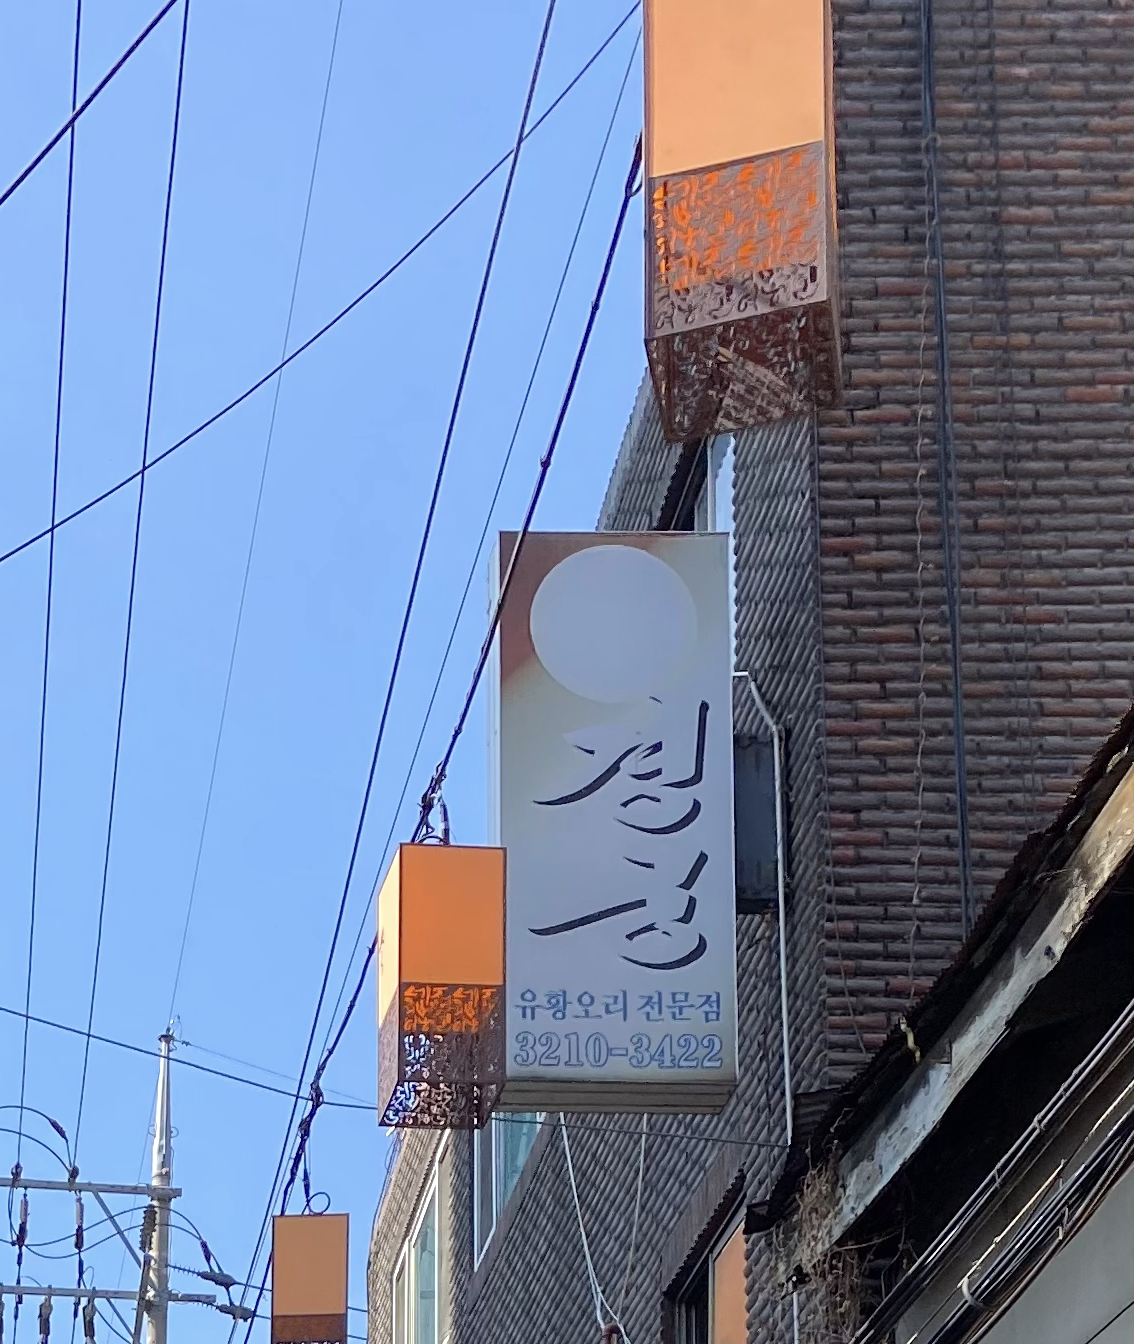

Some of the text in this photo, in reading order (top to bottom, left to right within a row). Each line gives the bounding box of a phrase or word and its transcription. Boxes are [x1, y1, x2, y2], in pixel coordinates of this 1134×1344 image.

[514, 988, 722, 1023] 유황오리 전문점
[514, 1031, 723, 1069] 3210-3422
